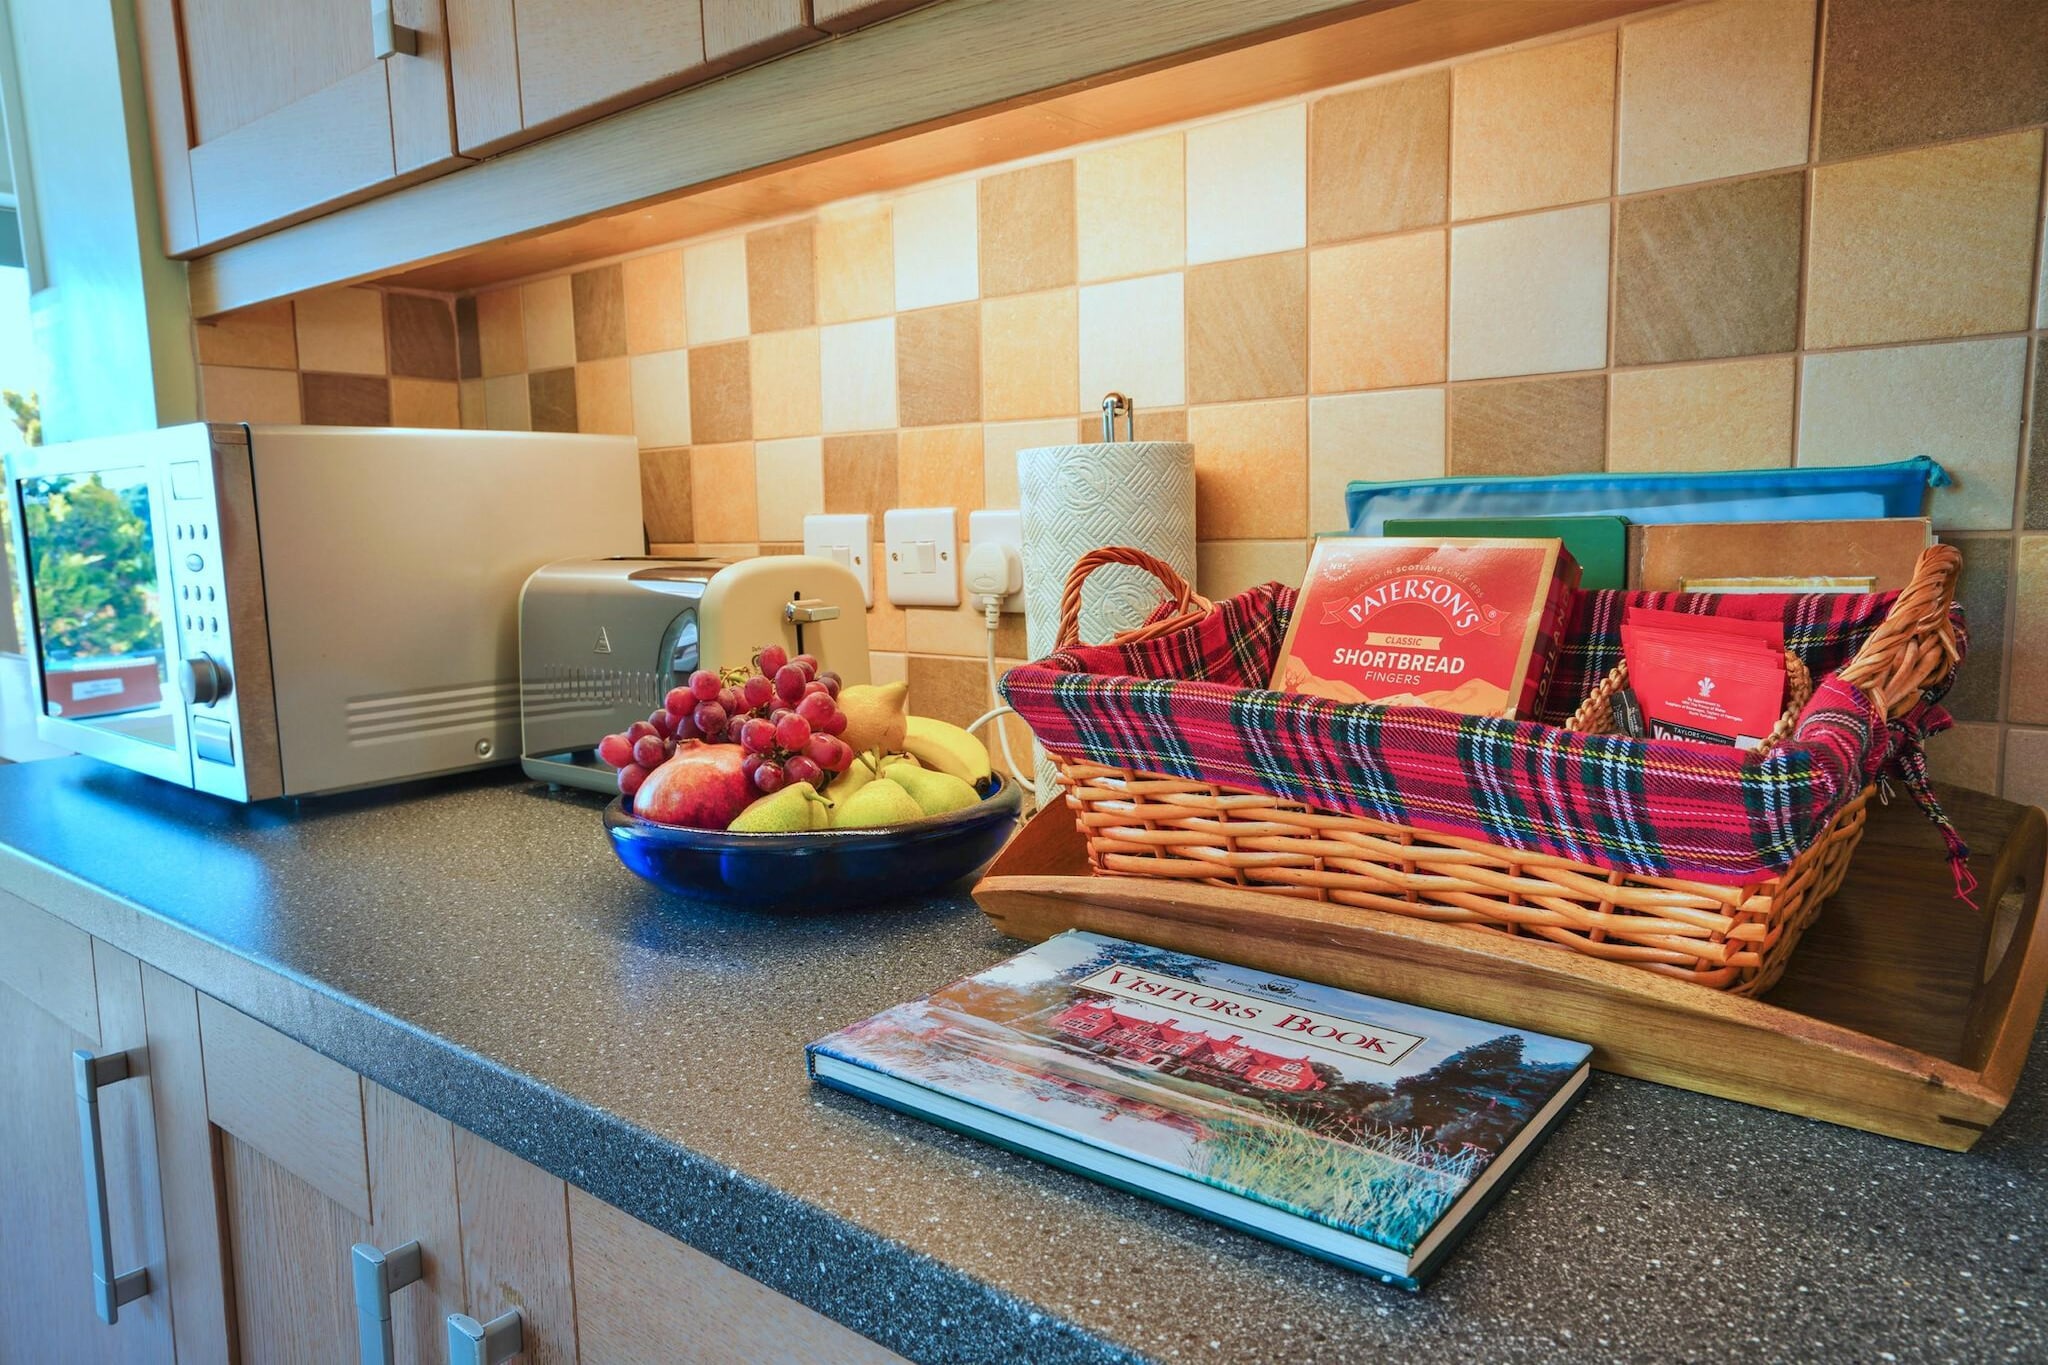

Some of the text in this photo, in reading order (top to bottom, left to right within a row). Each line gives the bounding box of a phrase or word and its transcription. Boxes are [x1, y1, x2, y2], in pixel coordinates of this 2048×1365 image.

[1396, 564, 1444, 573] SCOTLAND
[1446, 568, 1469, 584] SINCE
[1348, 579, 1479, 628] PATERSON'S
[1384, 635, 1422, 647] CLASSIC
[1533, 583, 1570, 716] COTLAND
[1332, 647, 1465, 675] SHORTBREAD
[1364, 671, 1421, 686] FINGERS
[1674, 727, 1700, 739] TAYLORS
[1108, 970, 1397, 1055] VISITORS BOOK
